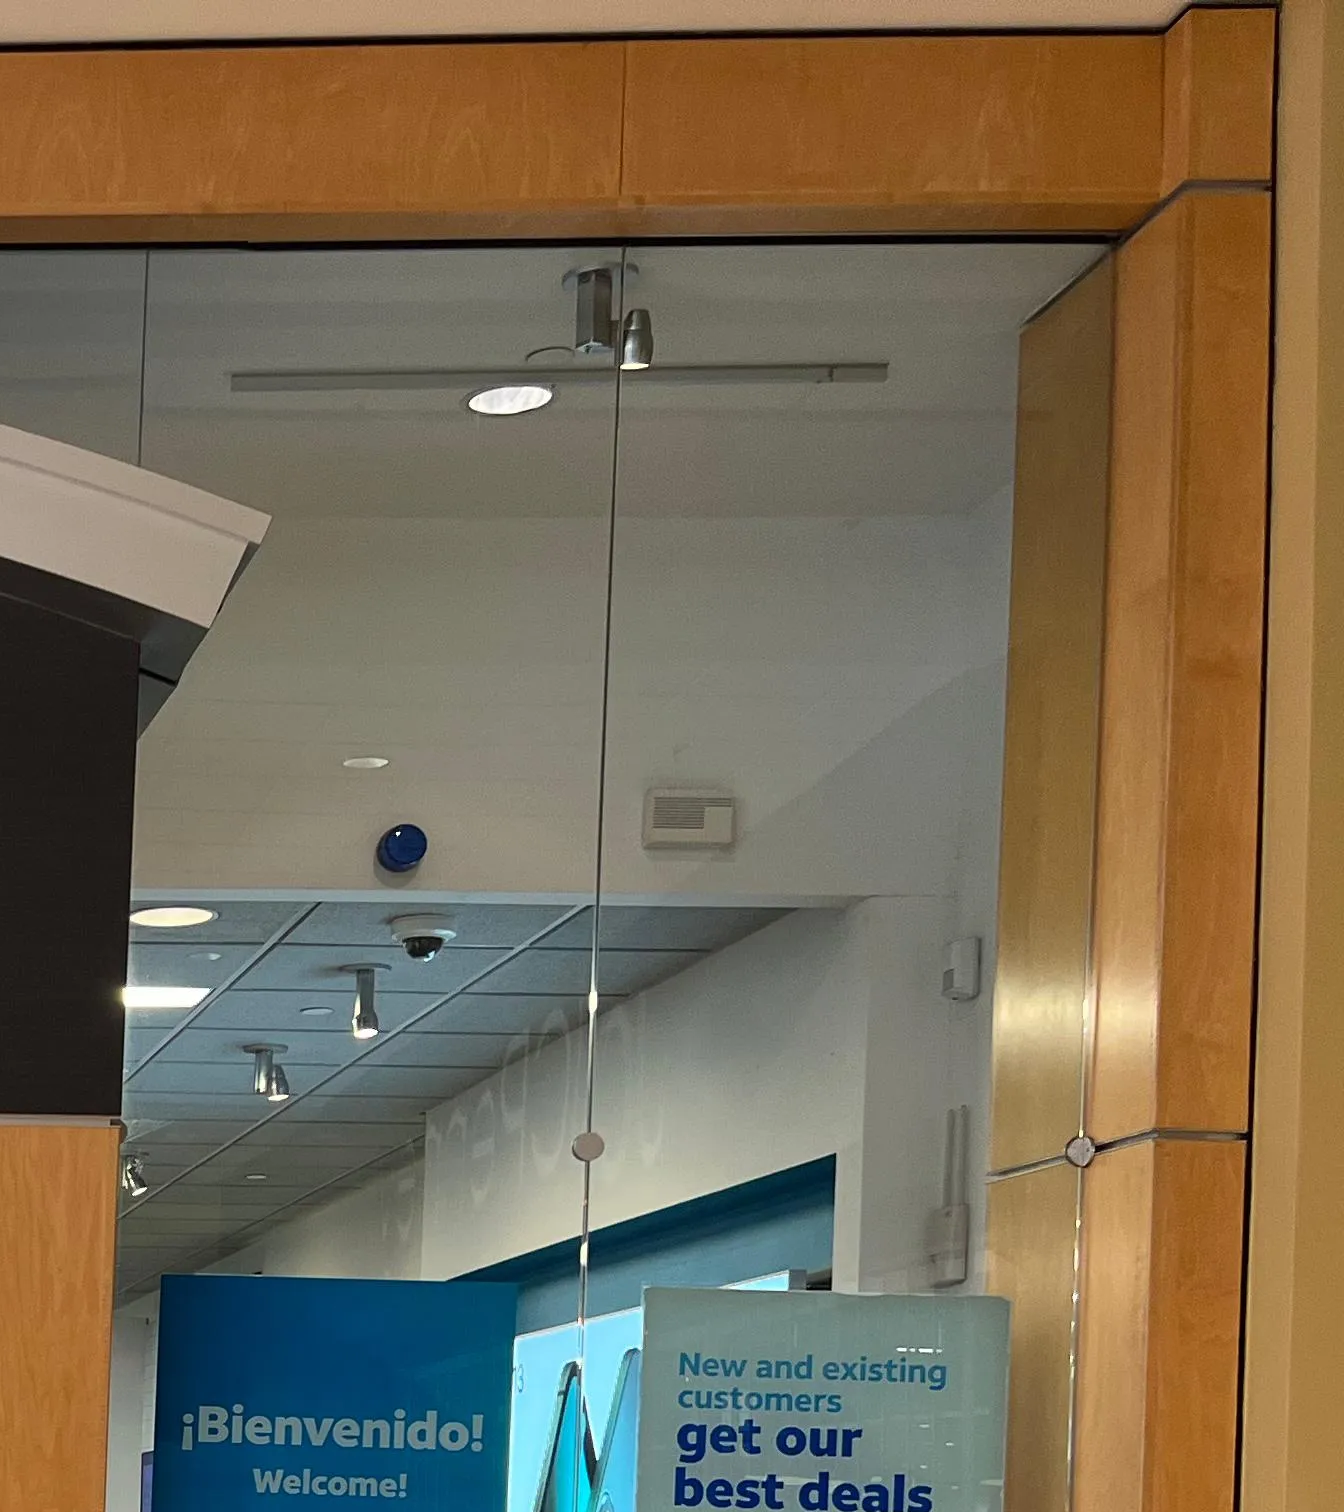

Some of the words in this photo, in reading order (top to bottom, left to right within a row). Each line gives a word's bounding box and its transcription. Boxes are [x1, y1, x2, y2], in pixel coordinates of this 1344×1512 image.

[678, 1352, 748, 1377] New
[756, 1355, 813, 1380] and
[822, 1356, 947, 1391] existing
[677, 1387, 843, 1413] customers
[181, 1403, 484, 1452] ¡Bienvenido!
[676, 1419, 762, 1463] get
[776, 1426, 863, 1457] our
[253, 1468, 408, 1498] Welcome!
[674, 1467, 785, 1510] best
